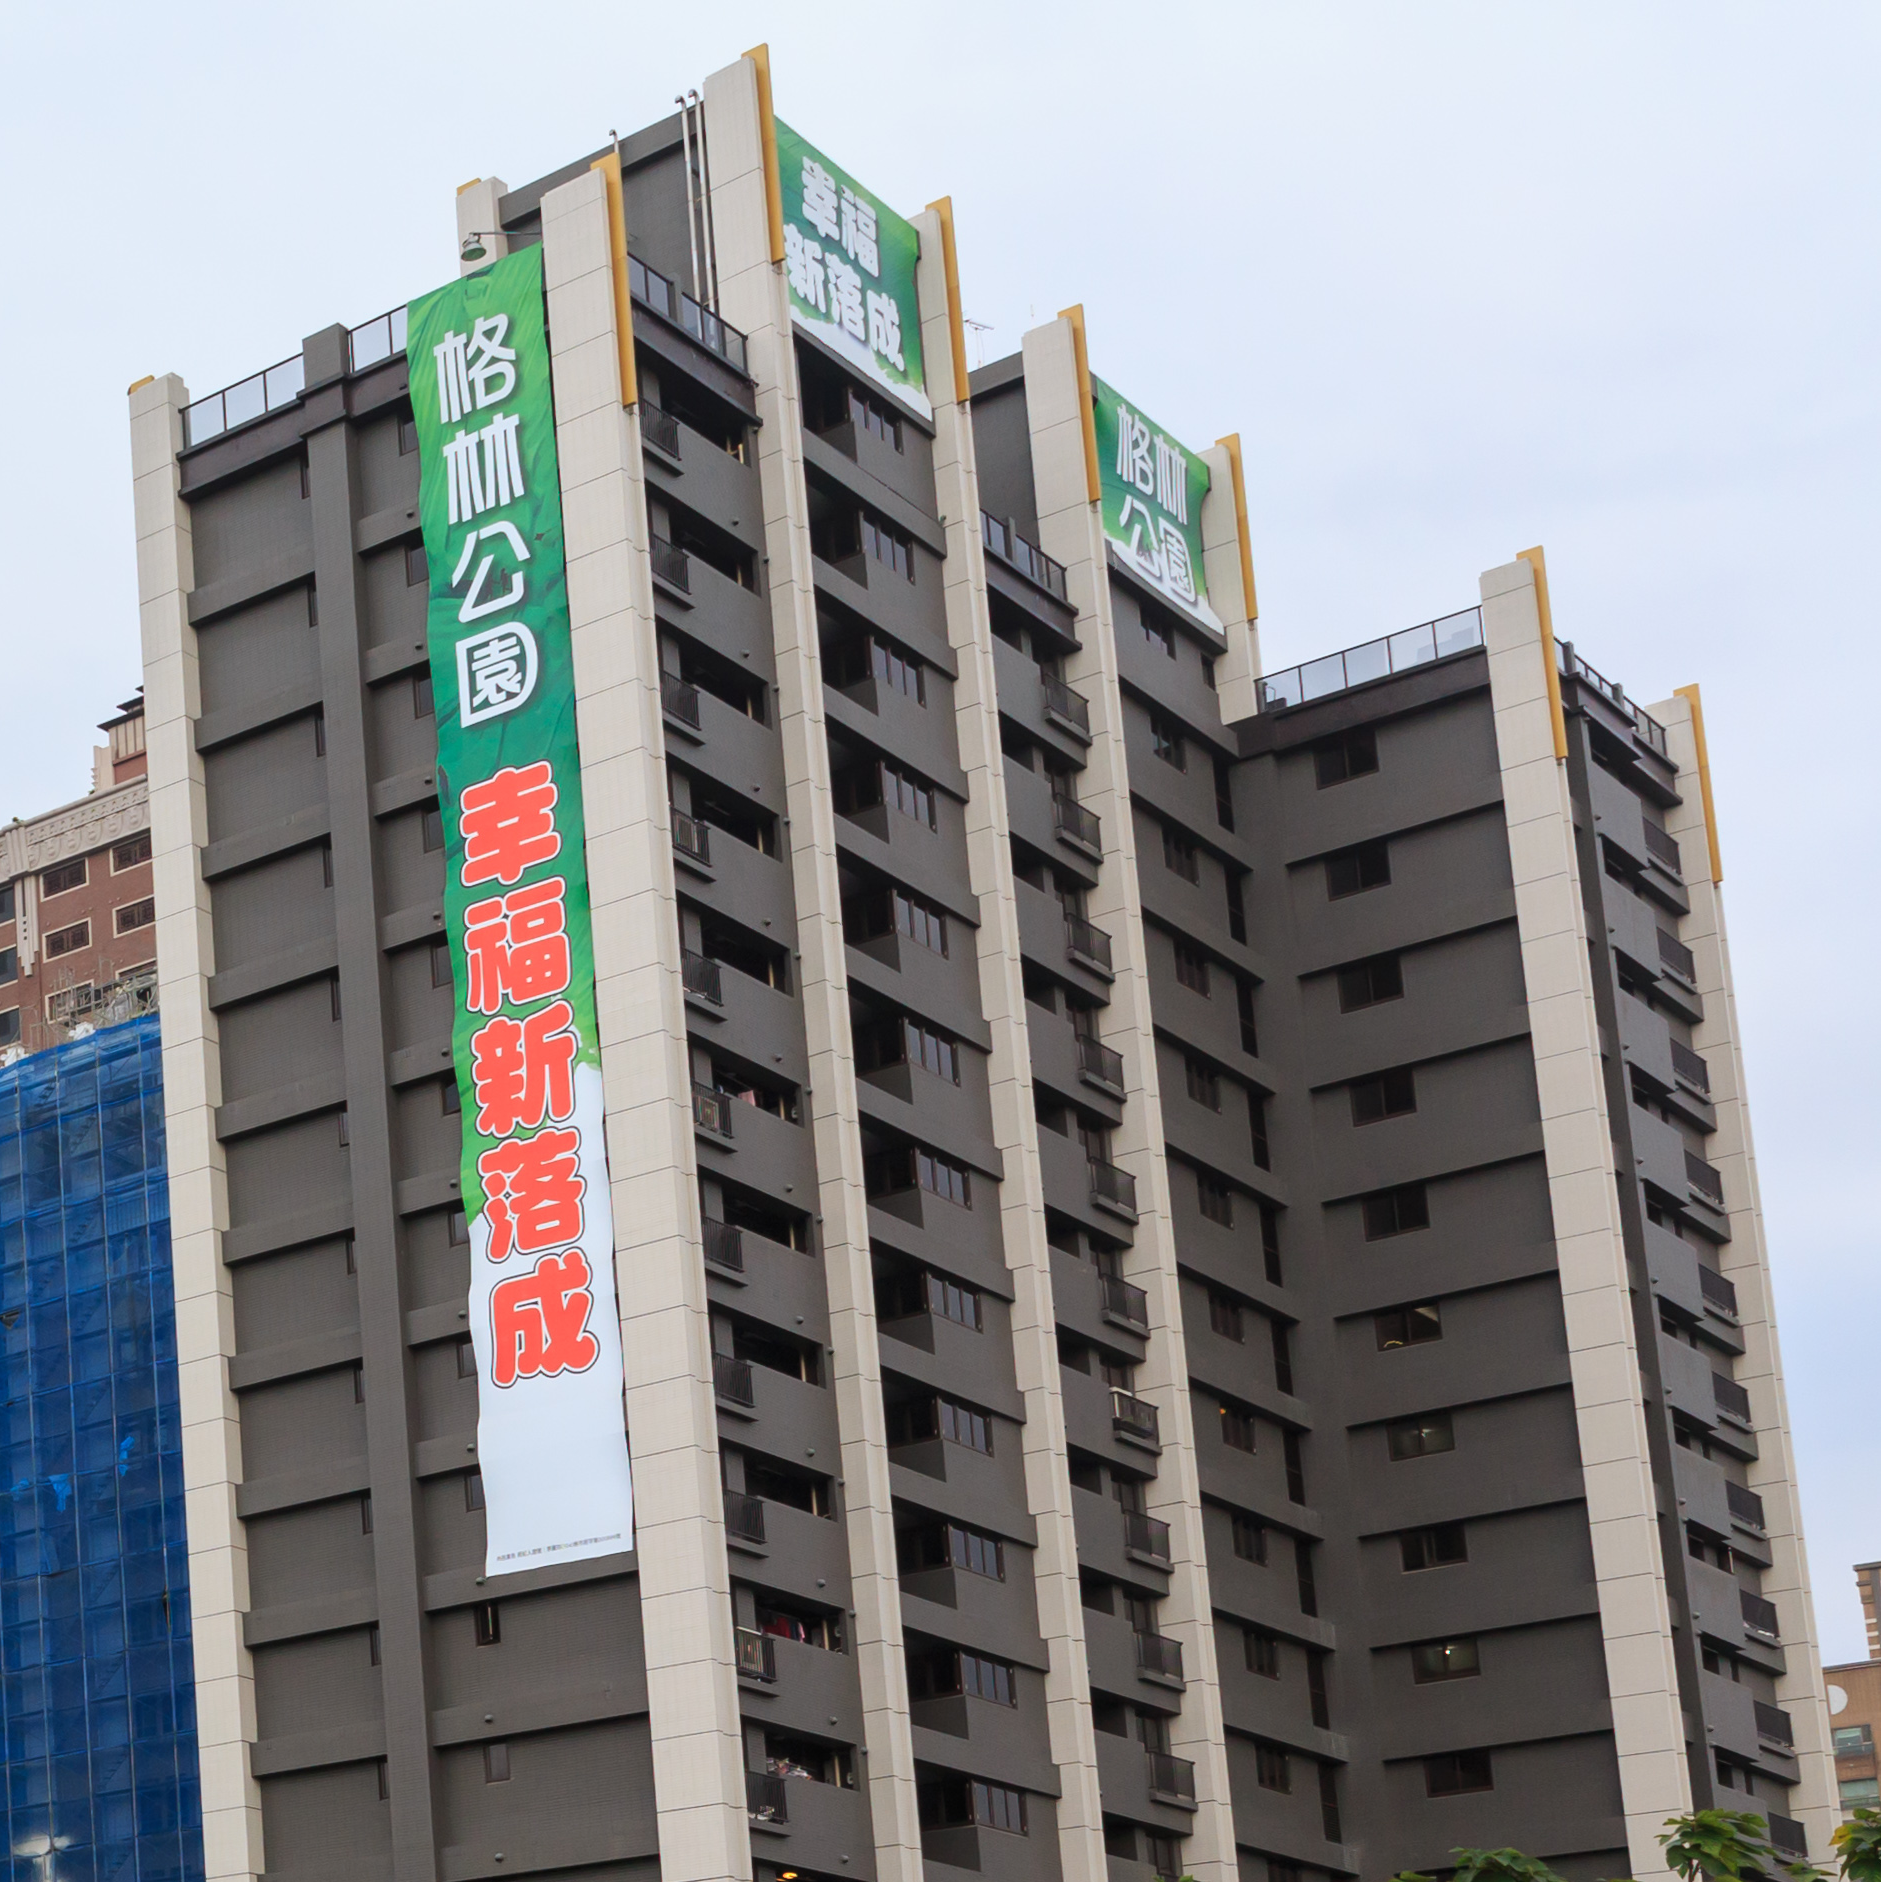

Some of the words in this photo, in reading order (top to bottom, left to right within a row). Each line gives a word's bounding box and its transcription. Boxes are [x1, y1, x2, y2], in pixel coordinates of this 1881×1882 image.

[801, 156, 879, 278] 幸福
[784, 223, 905, 371] 新落成
[433, 313, 539, 728] 格林公園
[1116, 403, 1188, 525] 格林
[1119, 494, 1197, 602] 公園
[459, 758, 600, 1389] 幸福新落成
